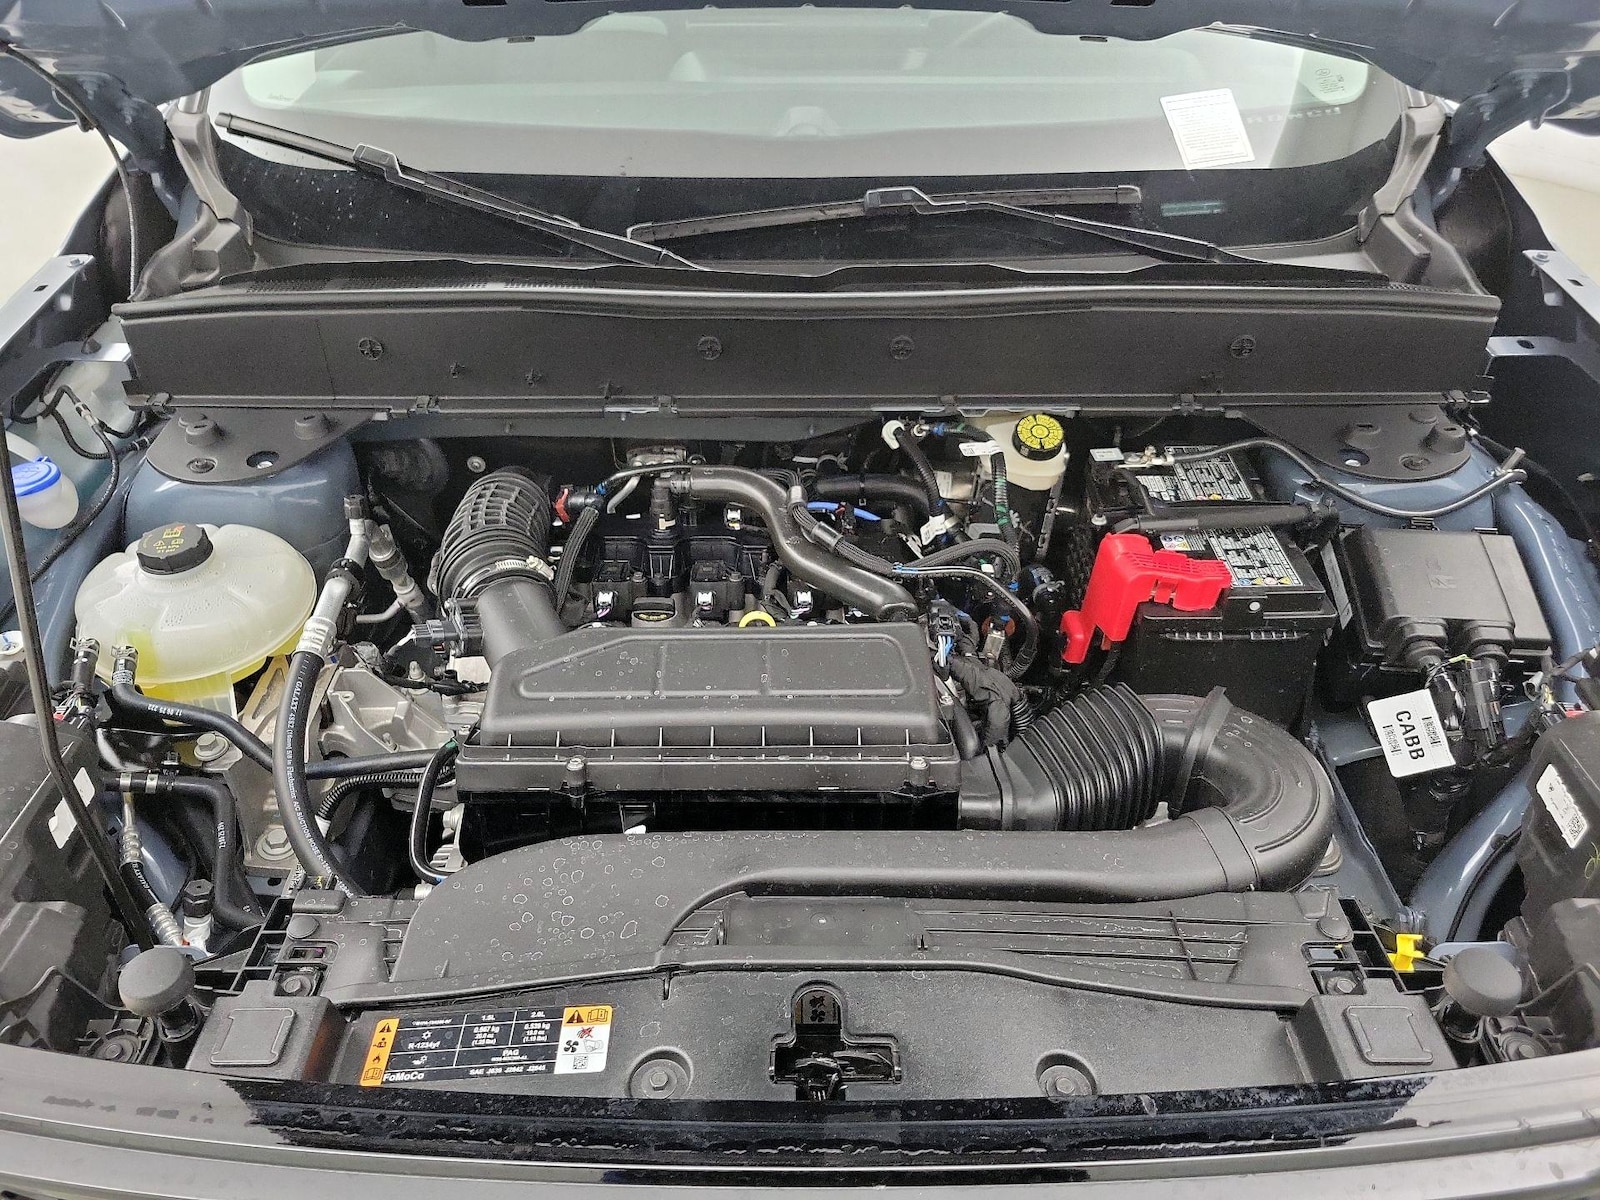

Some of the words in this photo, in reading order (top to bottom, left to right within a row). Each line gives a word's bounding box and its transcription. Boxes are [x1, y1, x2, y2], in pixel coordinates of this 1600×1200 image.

[1396, 710, 1425, 760] CABB
[290, 681, 302, 712] GALAXY
[296, 811, 312, 839] SUCTION
[307, 836, 321, 856] HOSE
[408, 1040, 441, 1049] R-1234yf
[383, 1071, 424, 1082] FoMoCo
